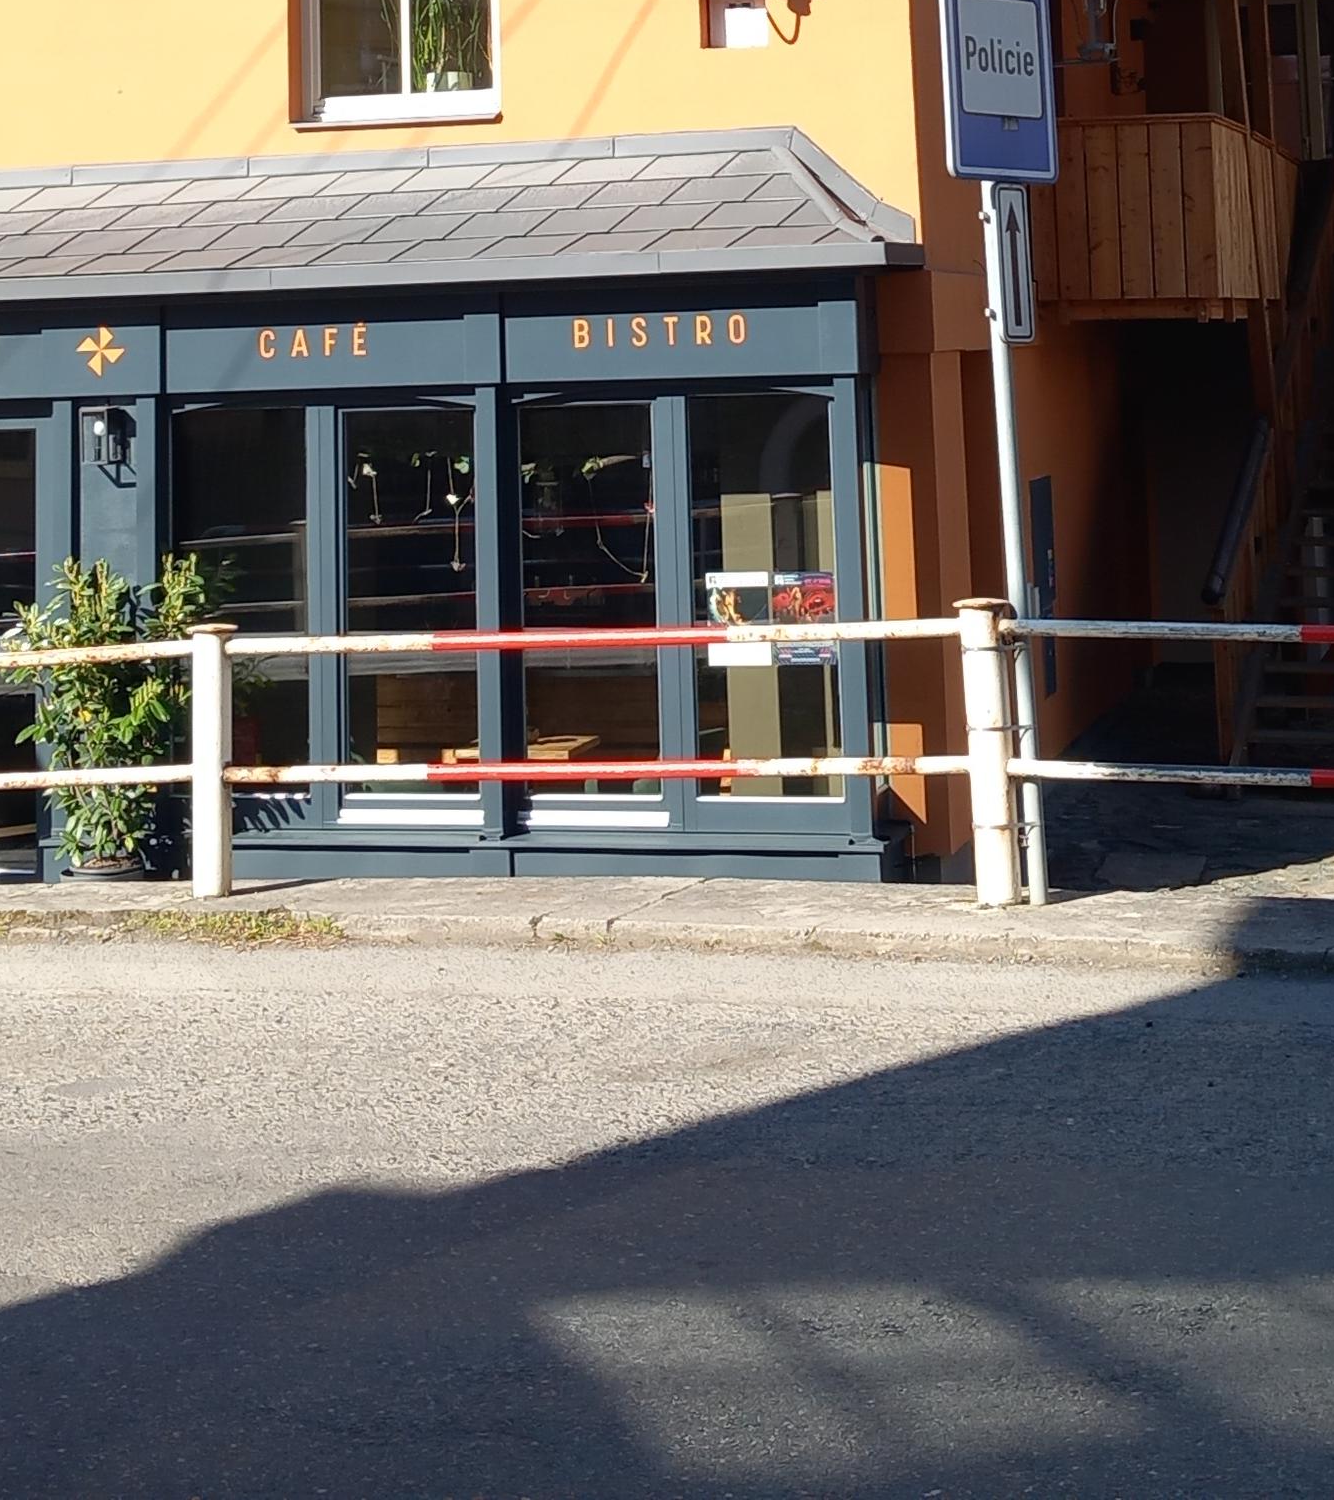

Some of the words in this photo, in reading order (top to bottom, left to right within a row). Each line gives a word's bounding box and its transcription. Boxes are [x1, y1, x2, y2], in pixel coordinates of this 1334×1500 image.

[965, 35, 1034, 77] Policie
[258, 320, 367, 358] CAFÉ
[572, 313, 748, 349] BISTRO
